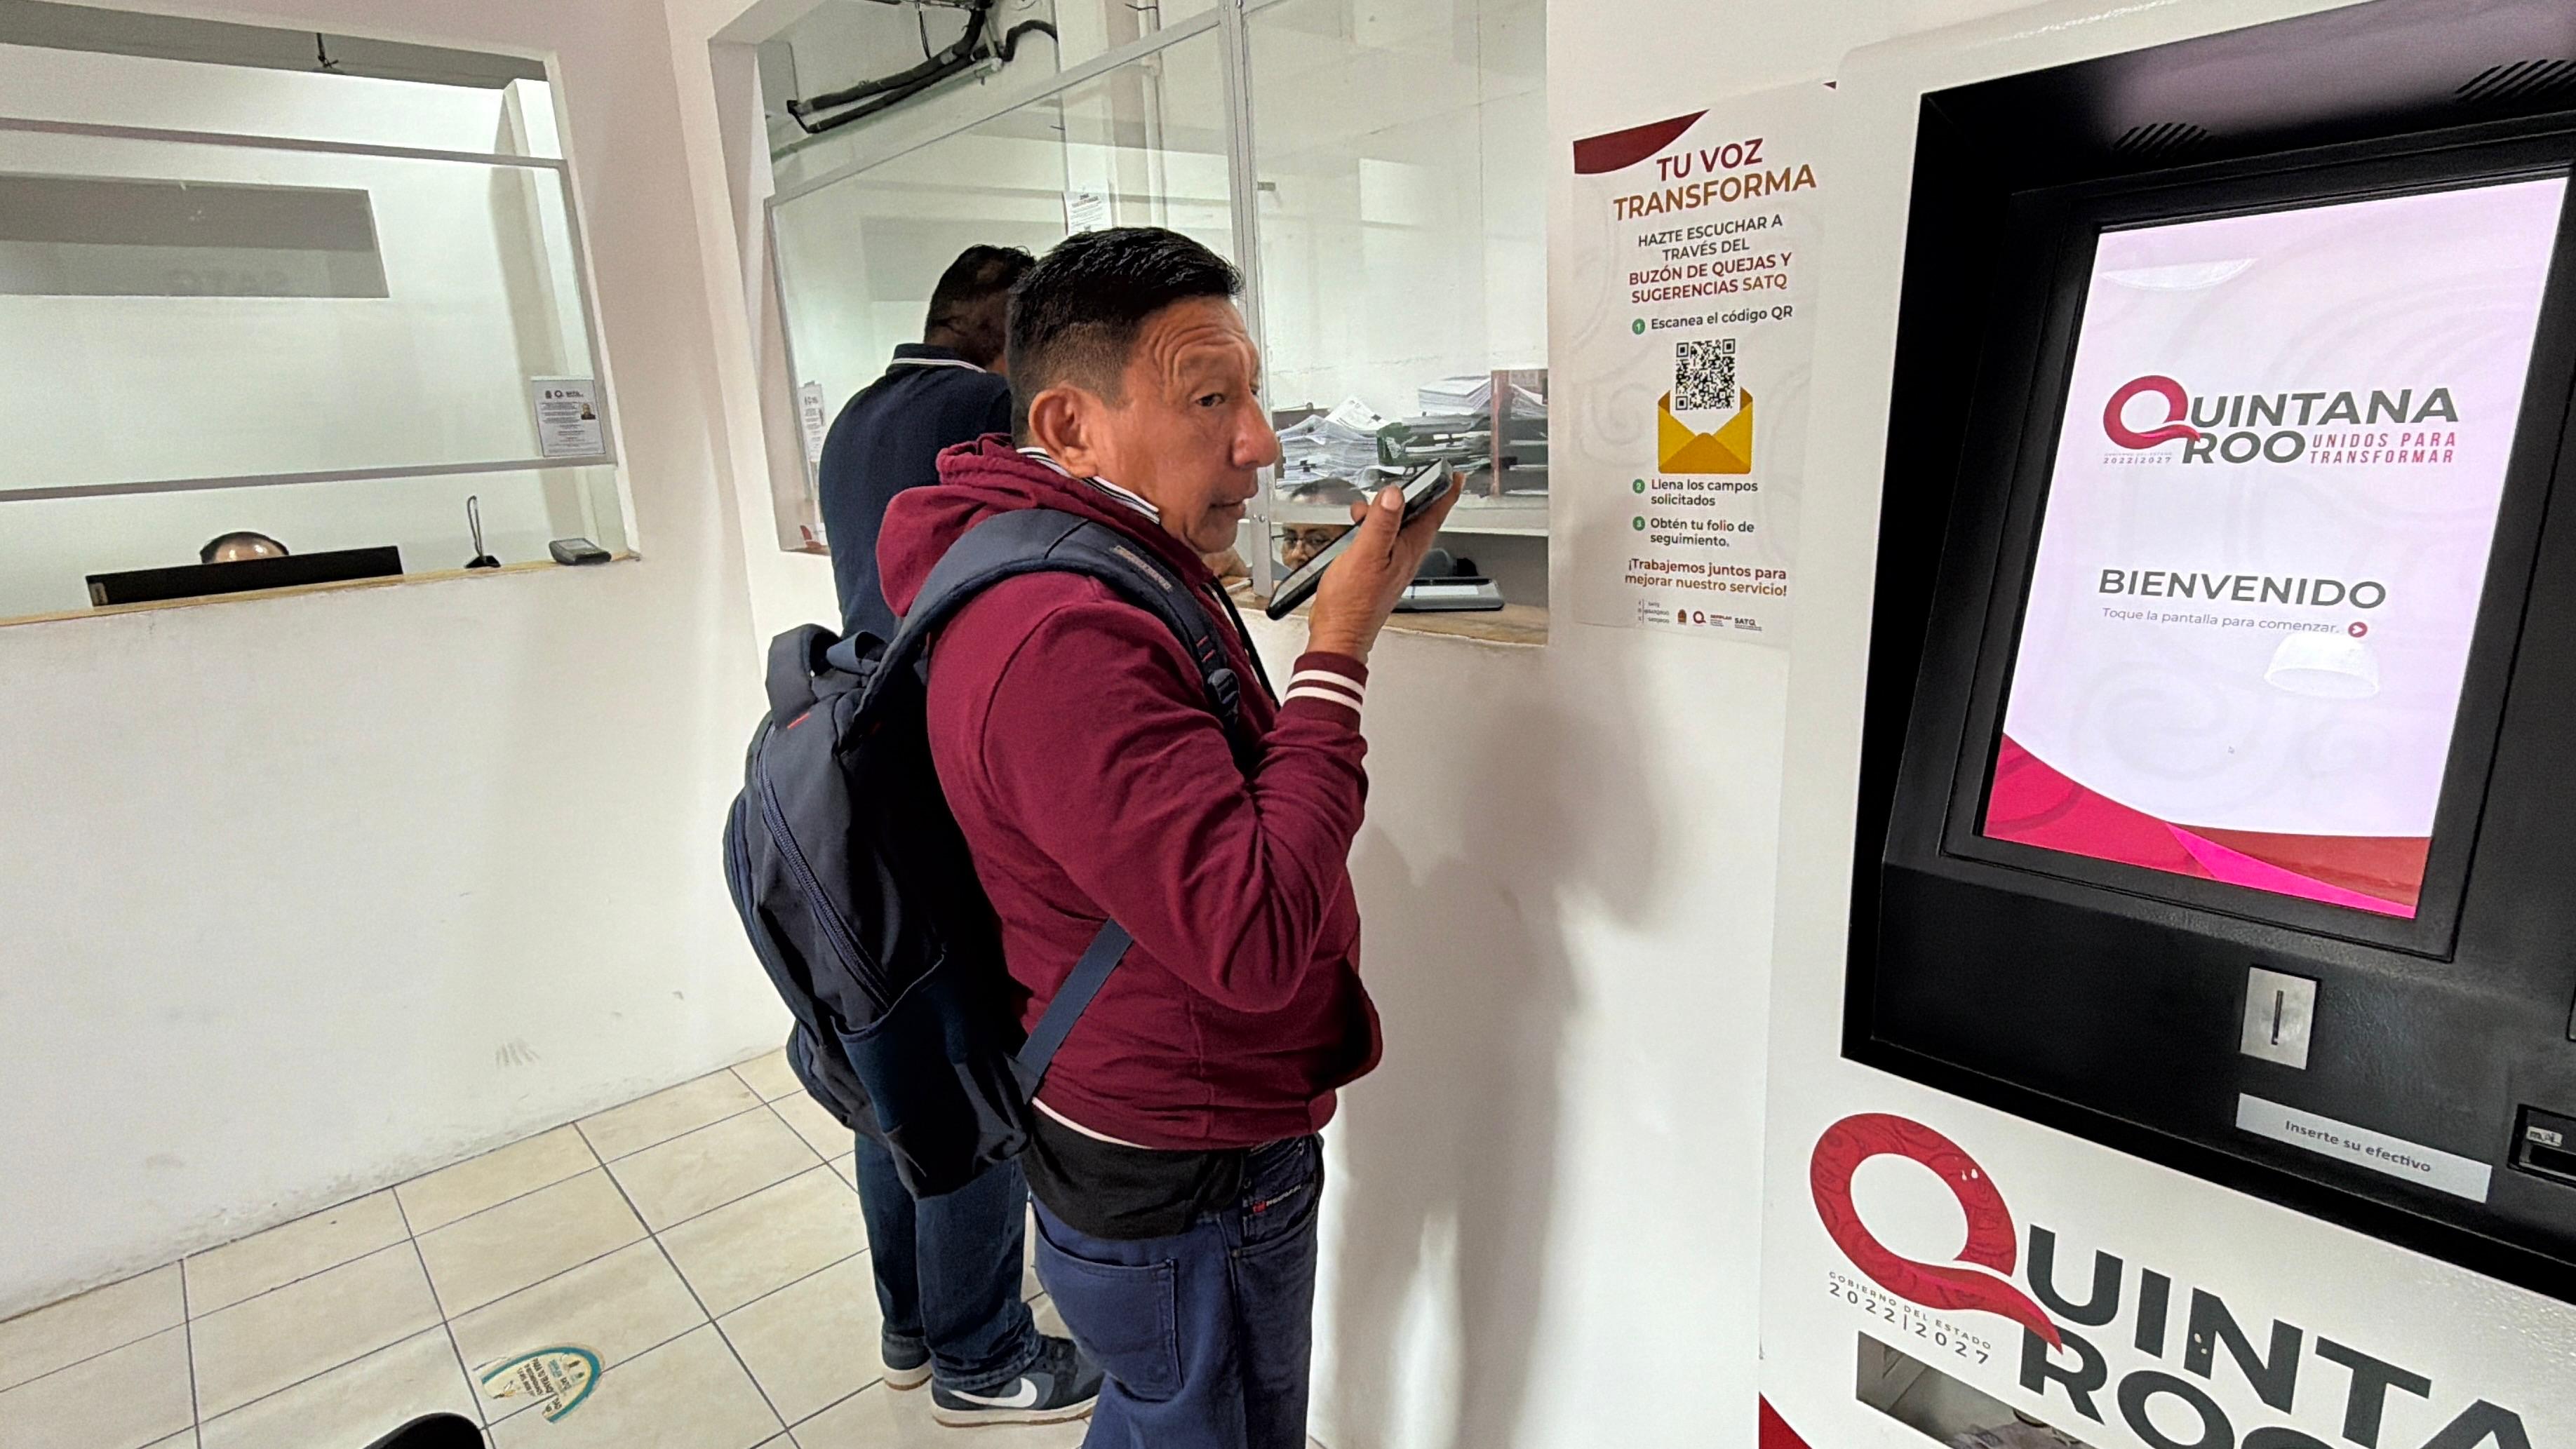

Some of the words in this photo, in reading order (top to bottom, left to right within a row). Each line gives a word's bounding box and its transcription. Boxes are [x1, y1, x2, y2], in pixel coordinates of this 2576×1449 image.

[1657, 153, 1691, 181] TU
[1700, 138, 1763, 173] VOZ
[1614, 163, 1816, 221] TRANSFORMA
[1638, 230, 1683, 247] HAZTE
[1686, 217, 1767, 240] ESCUCHAR
[1771, 215, 1783, 227] A
[1663, 241, 1717, 261] TRAVÉS
[1722, 238, 1750, 253] DEL
[1630, 265, 1682, 285] BUZÓN
[1686, 264, 1707, 278] DE
[1712, 254, 1776, 276] QUEJAS
[1781, 252, 1792, 266] Y
[1632, 279, 1738, 303] SUGERENCIAS
[1743, 274, 1787, 291] SATQ
[1651, 316, 1703, 329] Escanea
[1707, 313, 1717, 323] el
[1722, 309, 1767, 323] código
[1771, 305, 1792, 318] QR
[2103, 375, 2459, 450] QUINTANA
[2182, 431, 2306, 464] ROO
[2312, 433, 2388, 447] UNIDOS
[2401, 432, 2455, 447] PARA
[2310, 450, 2454, 464] TRANSFORMAR
[1651, 479, 1683, 490] Llena
[1687, 479, 1704, 490] los
[1708, 482, 1758, 494] campos
[1651, 494, 1715, 506] solicitados
[1651, 518, 1686, 530] Obtén
[1691, 520, 1703, 530] tu
[1707, 520, 1734, 531] folio
[1738, 521, 1754, 532] de
[1650, 533, 1729, 547] seguimiento.
[1629, 558, 1705, 573] ¡Trabajemos
[1708, 562, 1751, 577] juntos
[1755, 568, 1786, 580] para
[1625, 574, 1672, 587] mejorar
[1676, 579, 1726, 591] nuestro
[1730, 584, 1787, 596] servicio!
[2099, 570, 2386, 609] BIENVENIDO
[2102, 607, 2143, 621] Toque
[2147, 610, 2157, 621] la
[2161, 612, 2217, 625] pantalla
[2222, 617, 2254, 628] para
[2285, 1119, 2339, 1145] Inserte
[2342, 1138, 2361, 1152] su
[2366, 1143, 2431, 1173] efectivo
[1830, 1271, 1897, 1306] GOBIERNO
[1904, 1305, 1928, 1321] DEL
[1936, 1319, 1991, 1349] ESTADO
[2020, 1322, 2335, 1449] RO
